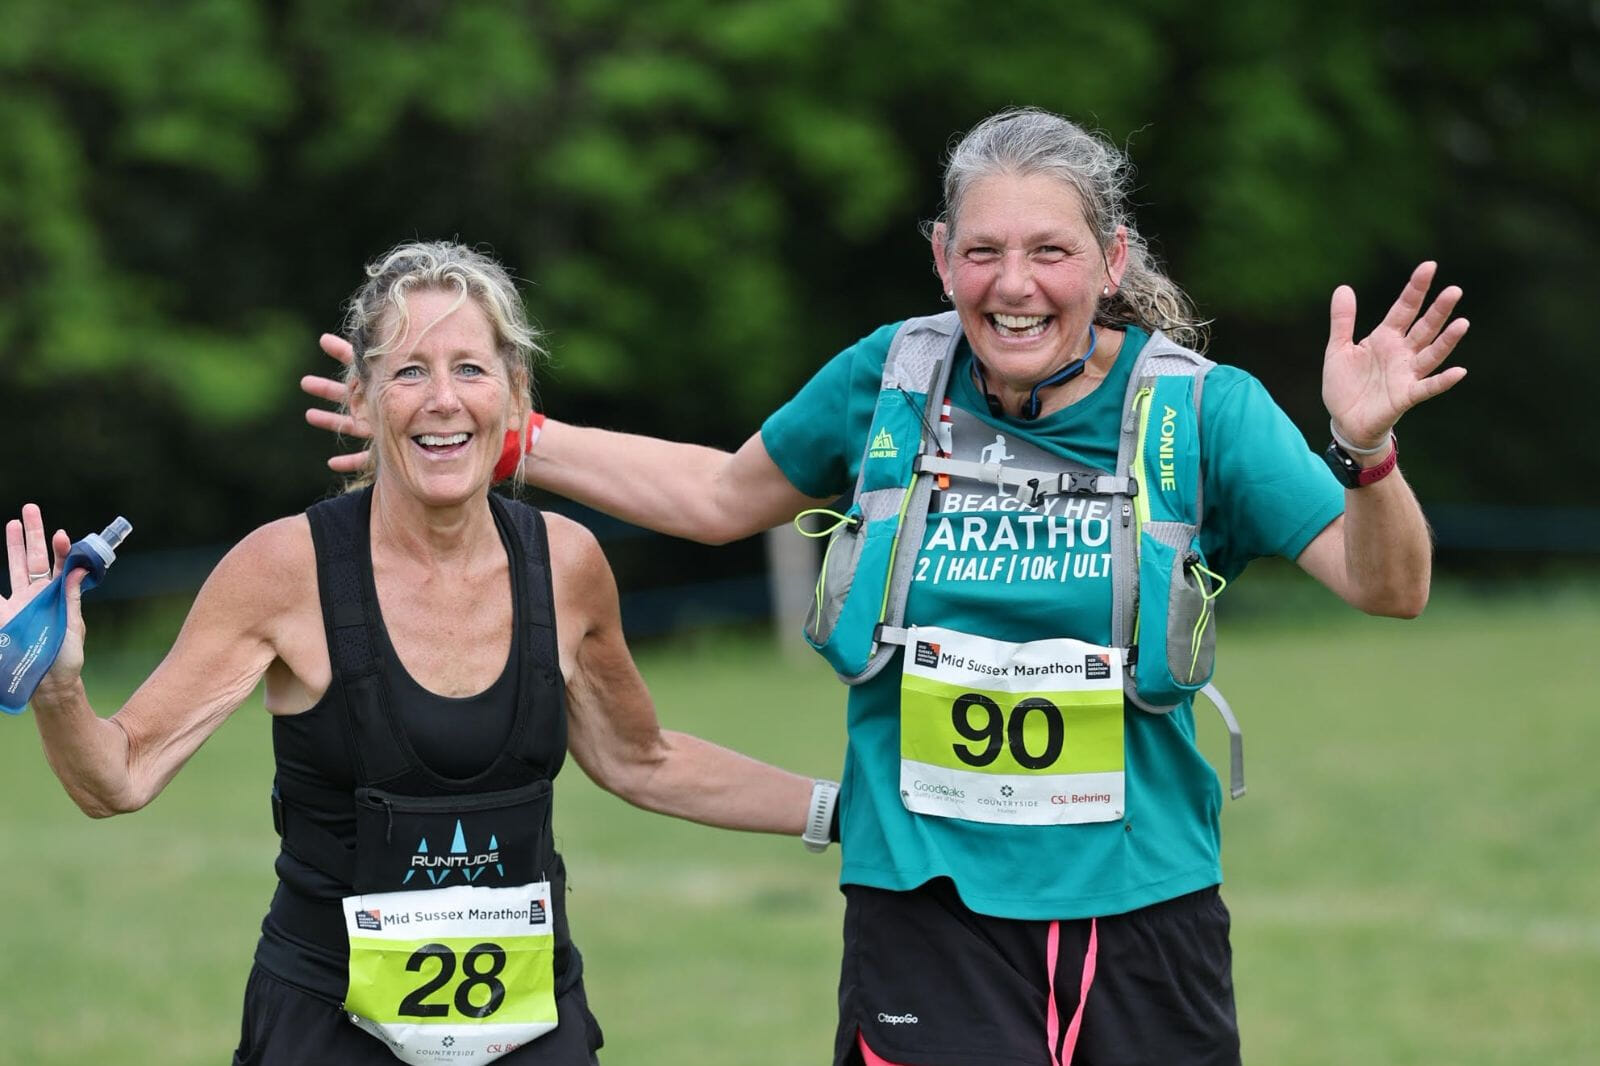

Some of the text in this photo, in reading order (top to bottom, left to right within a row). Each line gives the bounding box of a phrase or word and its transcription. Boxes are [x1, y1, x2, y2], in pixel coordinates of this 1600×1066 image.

[1159, 405, 1177, 492] AONIJIE
[1063, 498, 1111, 520] HE
[919, 515, 1109, 551] ARATHO
[946, 557, 1005, 581] HALF
[1020, 555, 1058, 581] 10k
[941, 652, 964, 668] Mid
[967, 660, 1009, 676] Sussex
[1014, 662, 1083, 676] Marathon
[952, 693, 1064, 770] 90
[914, 780, 965, 798] GoodOaks
[1051, 793, 1110, 804] CSL Behring
[977, 798, 1038, 807] COUNTRYSIDE
[411, 852, 499, 867] RUNITUDE
[384, 912, 410, 926] Mid
[415, 909, 464, 922] Sussex
[469, 908, 528, 920] Marathon
[397, 942, 506, 1018] 28
[487, 1044, 502, 1053] CSL
